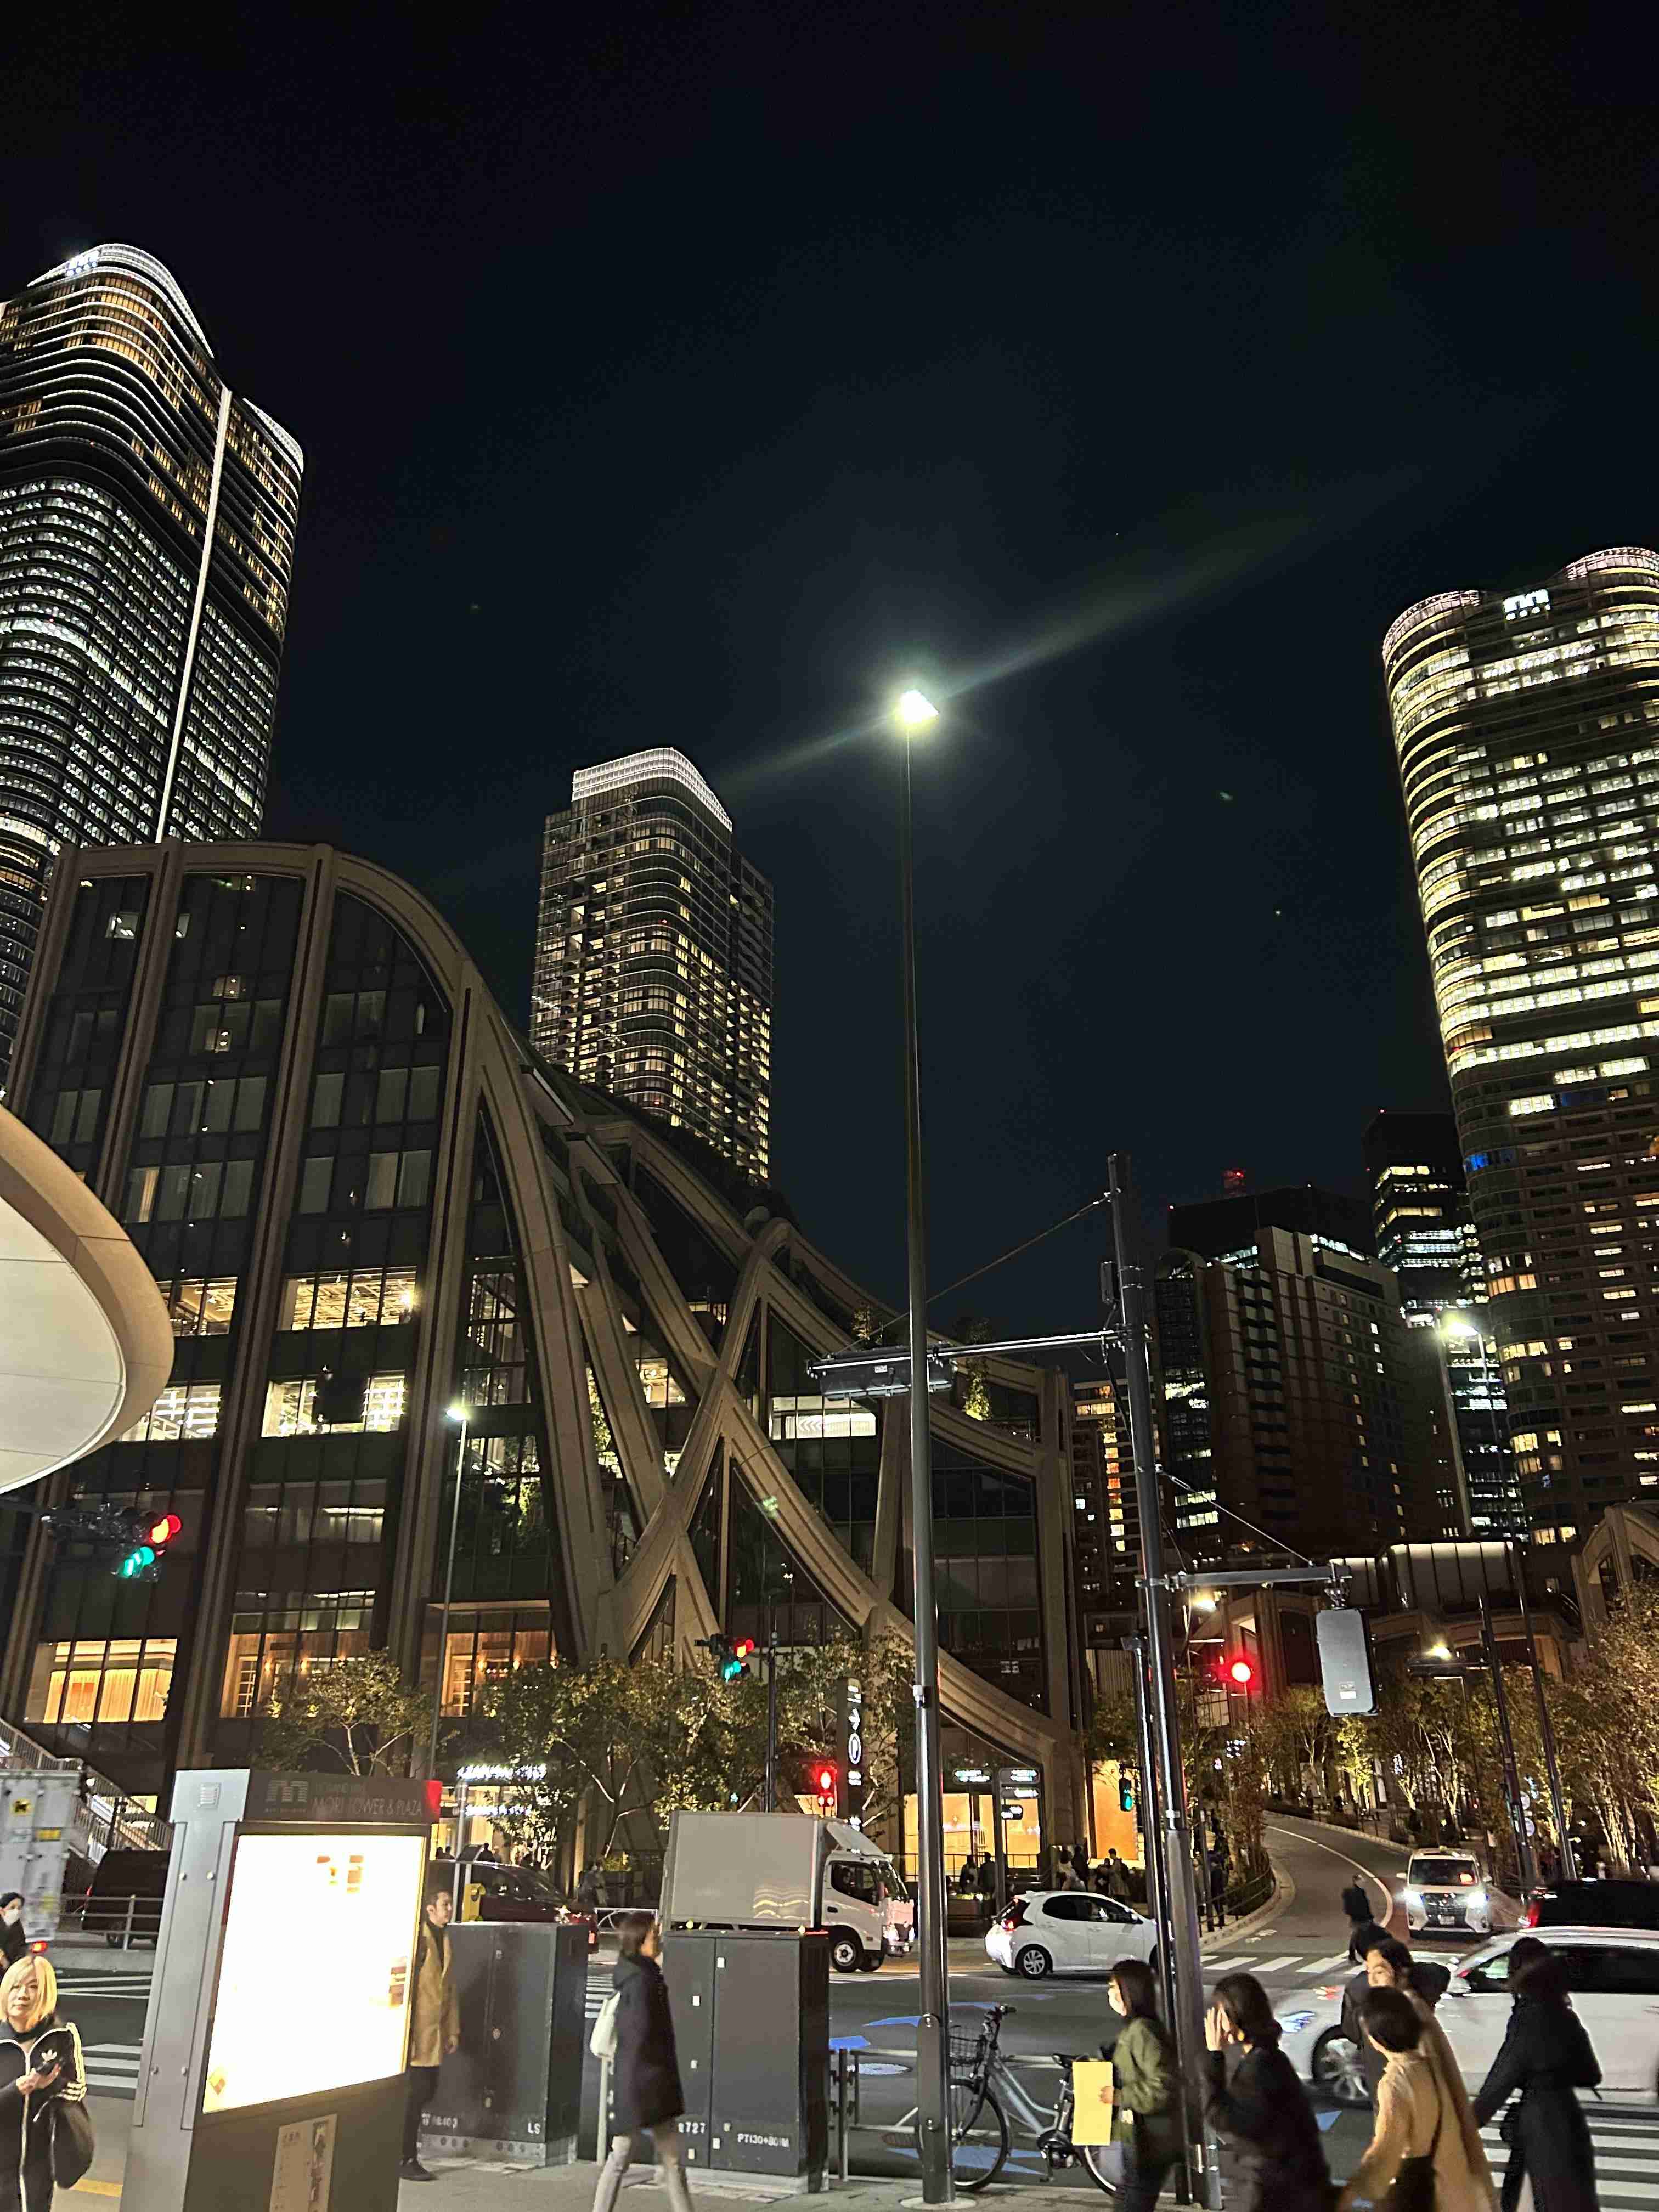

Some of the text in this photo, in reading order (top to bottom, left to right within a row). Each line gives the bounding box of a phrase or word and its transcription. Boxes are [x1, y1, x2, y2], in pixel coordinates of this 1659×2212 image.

[347, 1797, 385, 1815] TOWER
[396, 1799, 422, 1816] PLAZA
[527, 2122, 540, 2134] LS
